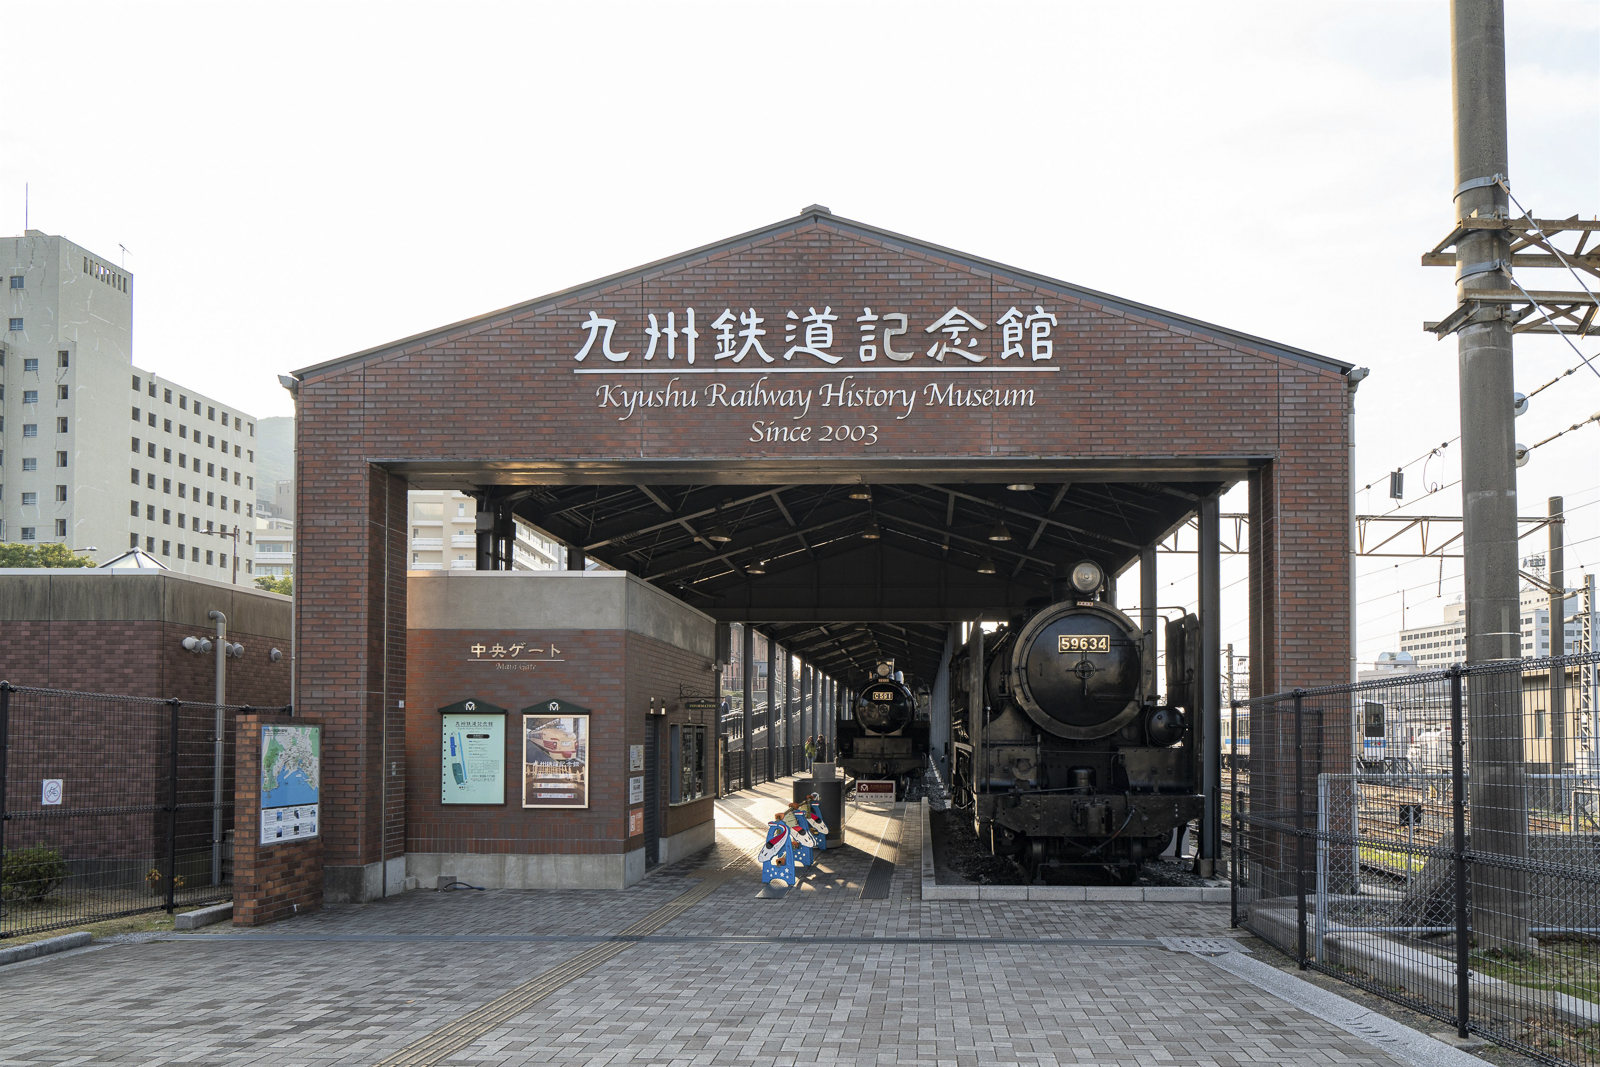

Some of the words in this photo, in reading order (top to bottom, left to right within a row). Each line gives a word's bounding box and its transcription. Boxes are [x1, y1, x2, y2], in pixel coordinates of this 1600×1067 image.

[573, 305, 1058, 364] 九州鉄道記念館
[595, 377, 698, 420] Kyushu
[704, 377, 812, 419] Railway
[819, 376, 916, 420] History
[923, 383, 1036, 406] Museum
[749, 421, 812, 443] Since
[818, 425, 878, 445] 2003
[471, 642, 561, 658] 中央ゲート
[1061, 637, 1107, 650] 59634
[495, 663, 517, 671] Main
[519, 663, 537, 672] Gate
